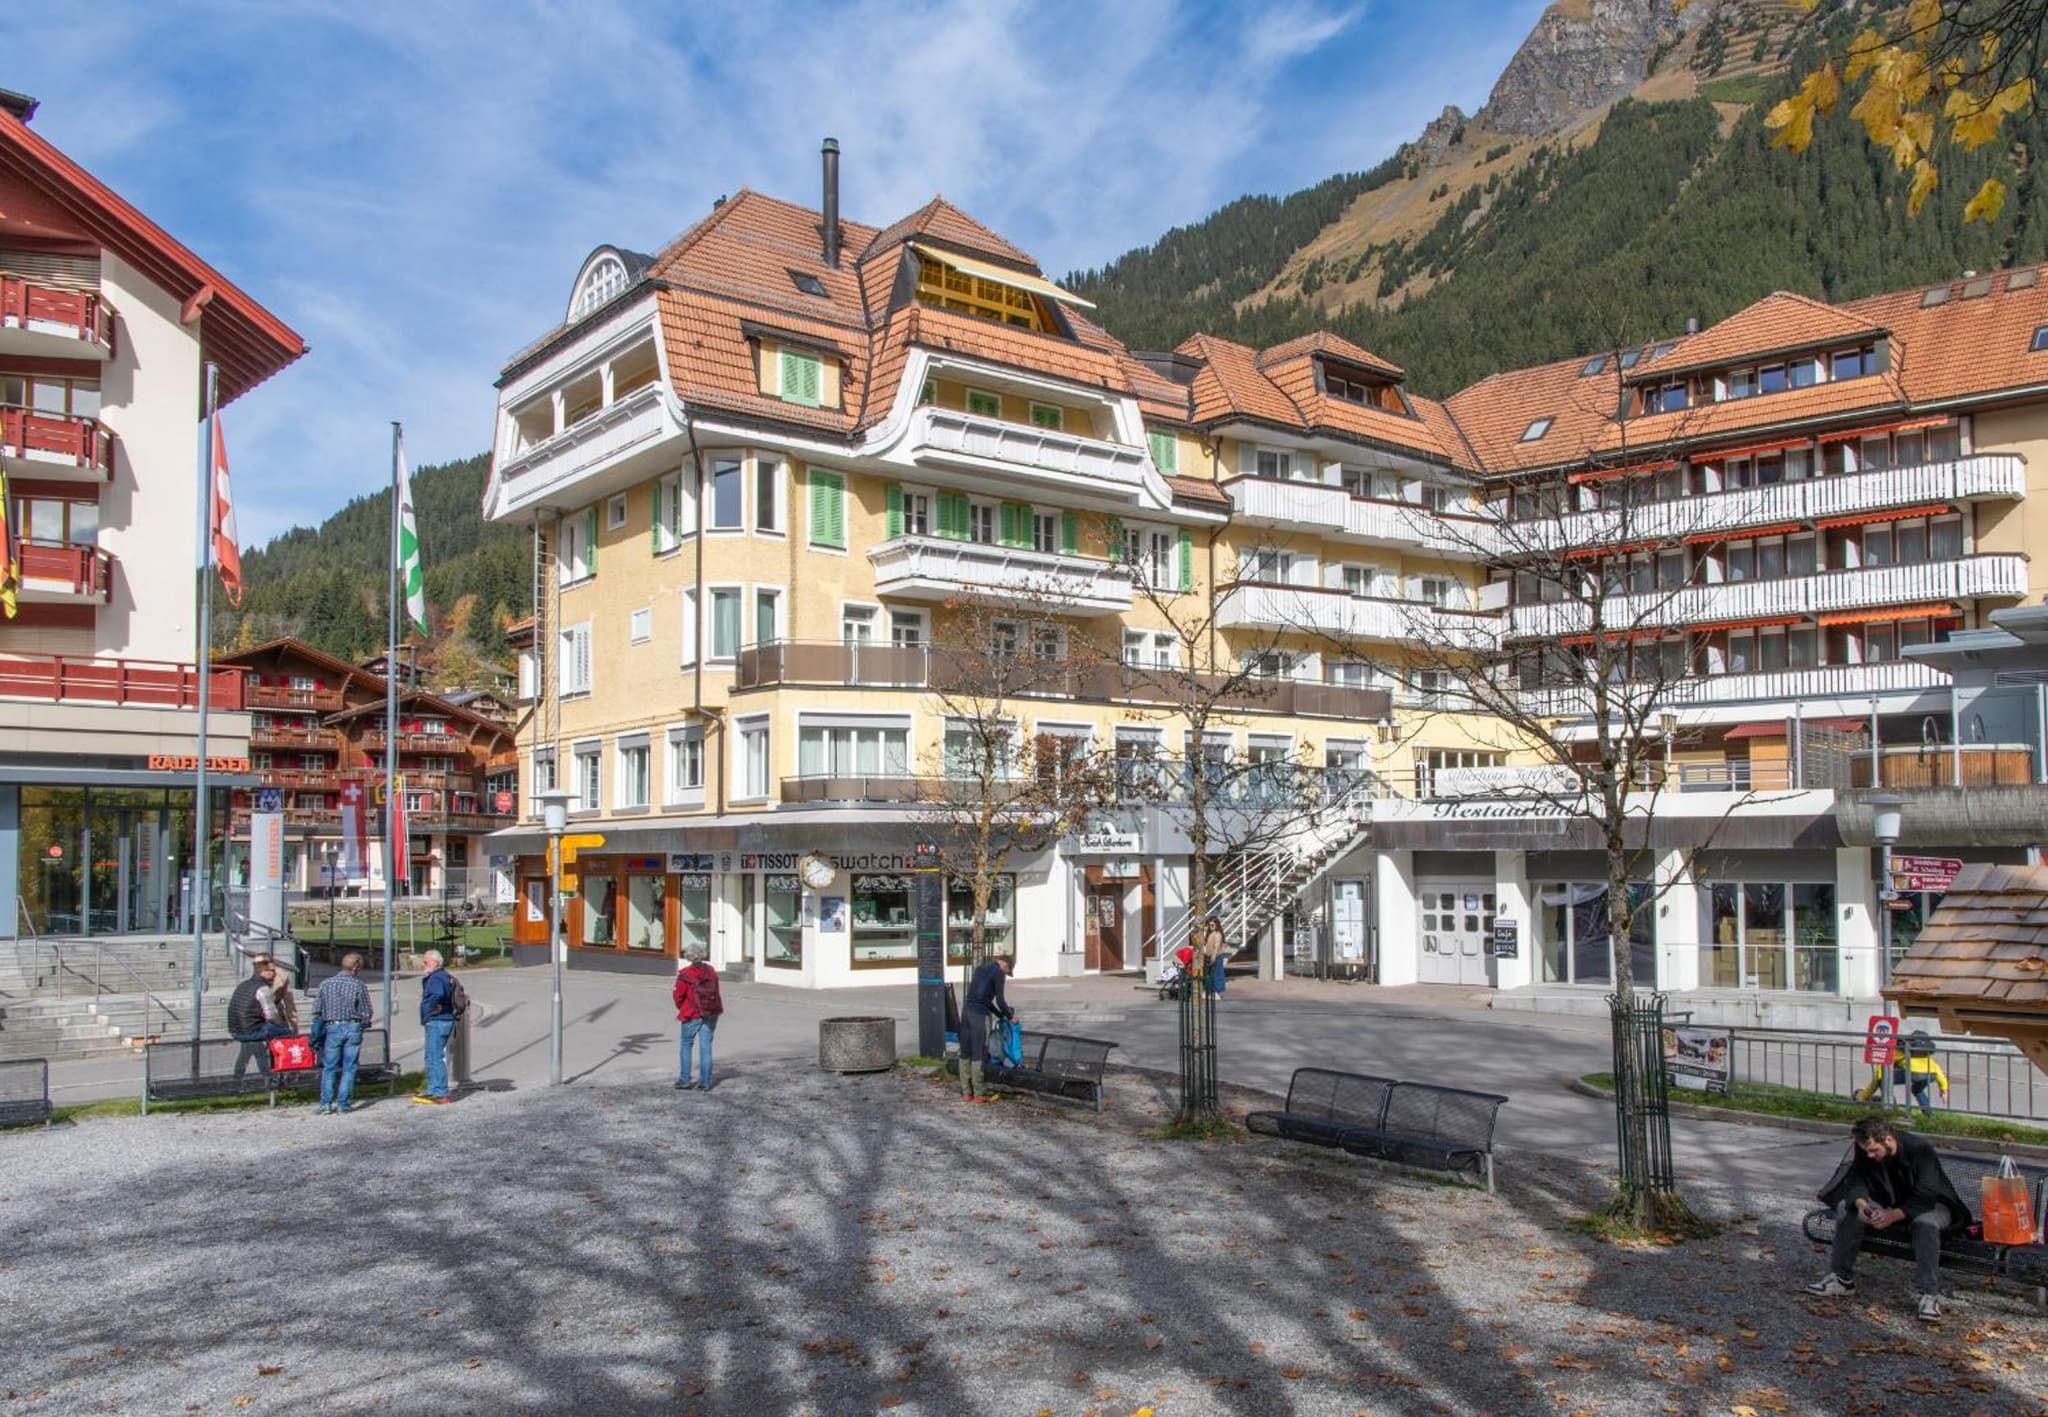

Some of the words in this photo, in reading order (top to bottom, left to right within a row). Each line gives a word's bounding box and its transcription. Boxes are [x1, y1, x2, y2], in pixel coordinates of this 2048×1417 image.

[1434, 801, 1575, 820] Restaurant
[757, 853, 799, 869] TISSOT
[831, 852, 898, 870] swatch
